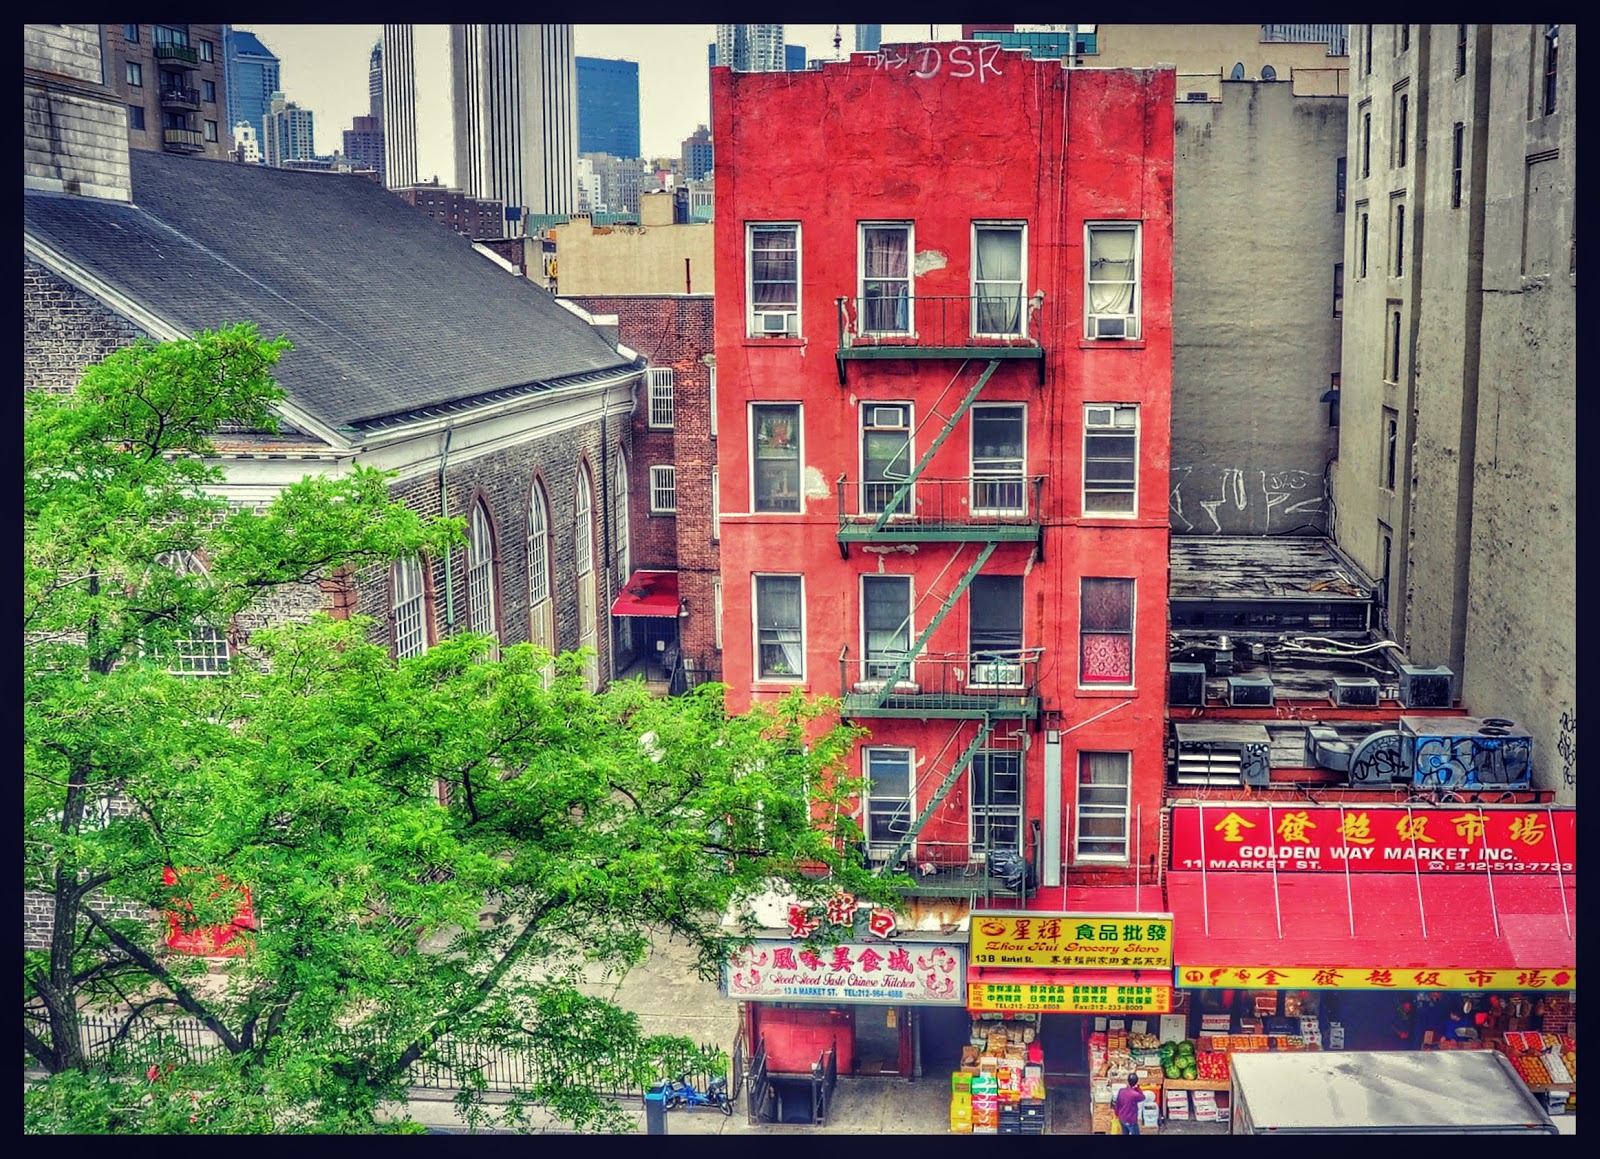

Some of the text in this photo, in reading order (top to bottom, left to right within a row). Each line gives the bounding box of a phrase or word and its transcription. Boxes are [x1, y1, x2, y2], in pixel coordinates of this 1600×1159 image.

[1214, 811, 1547, 845] 金發超級市場
[1239, 846, 1518, 861] GOLDEN WAY MARKET INC.
[1183, 859, 1322, 870] 11 MARKET ST.
[1454, 862, 1573, 872] 212-513-7733
[1075, 924, 1167, 942] 食品批發
[1064, 942, 1119, 955] Grocery
[1124, 943, 1160, 953] Store
[772, 947, 914, 974] 風味美食城
[1001, 955, 1023, 963] Market
[823, 973, 846, 987] Taste
[847, 973, 878, 988] Chinese
[880, 974, 916, 989] Kitchen
[799, 988, 826, 997] MARKET
